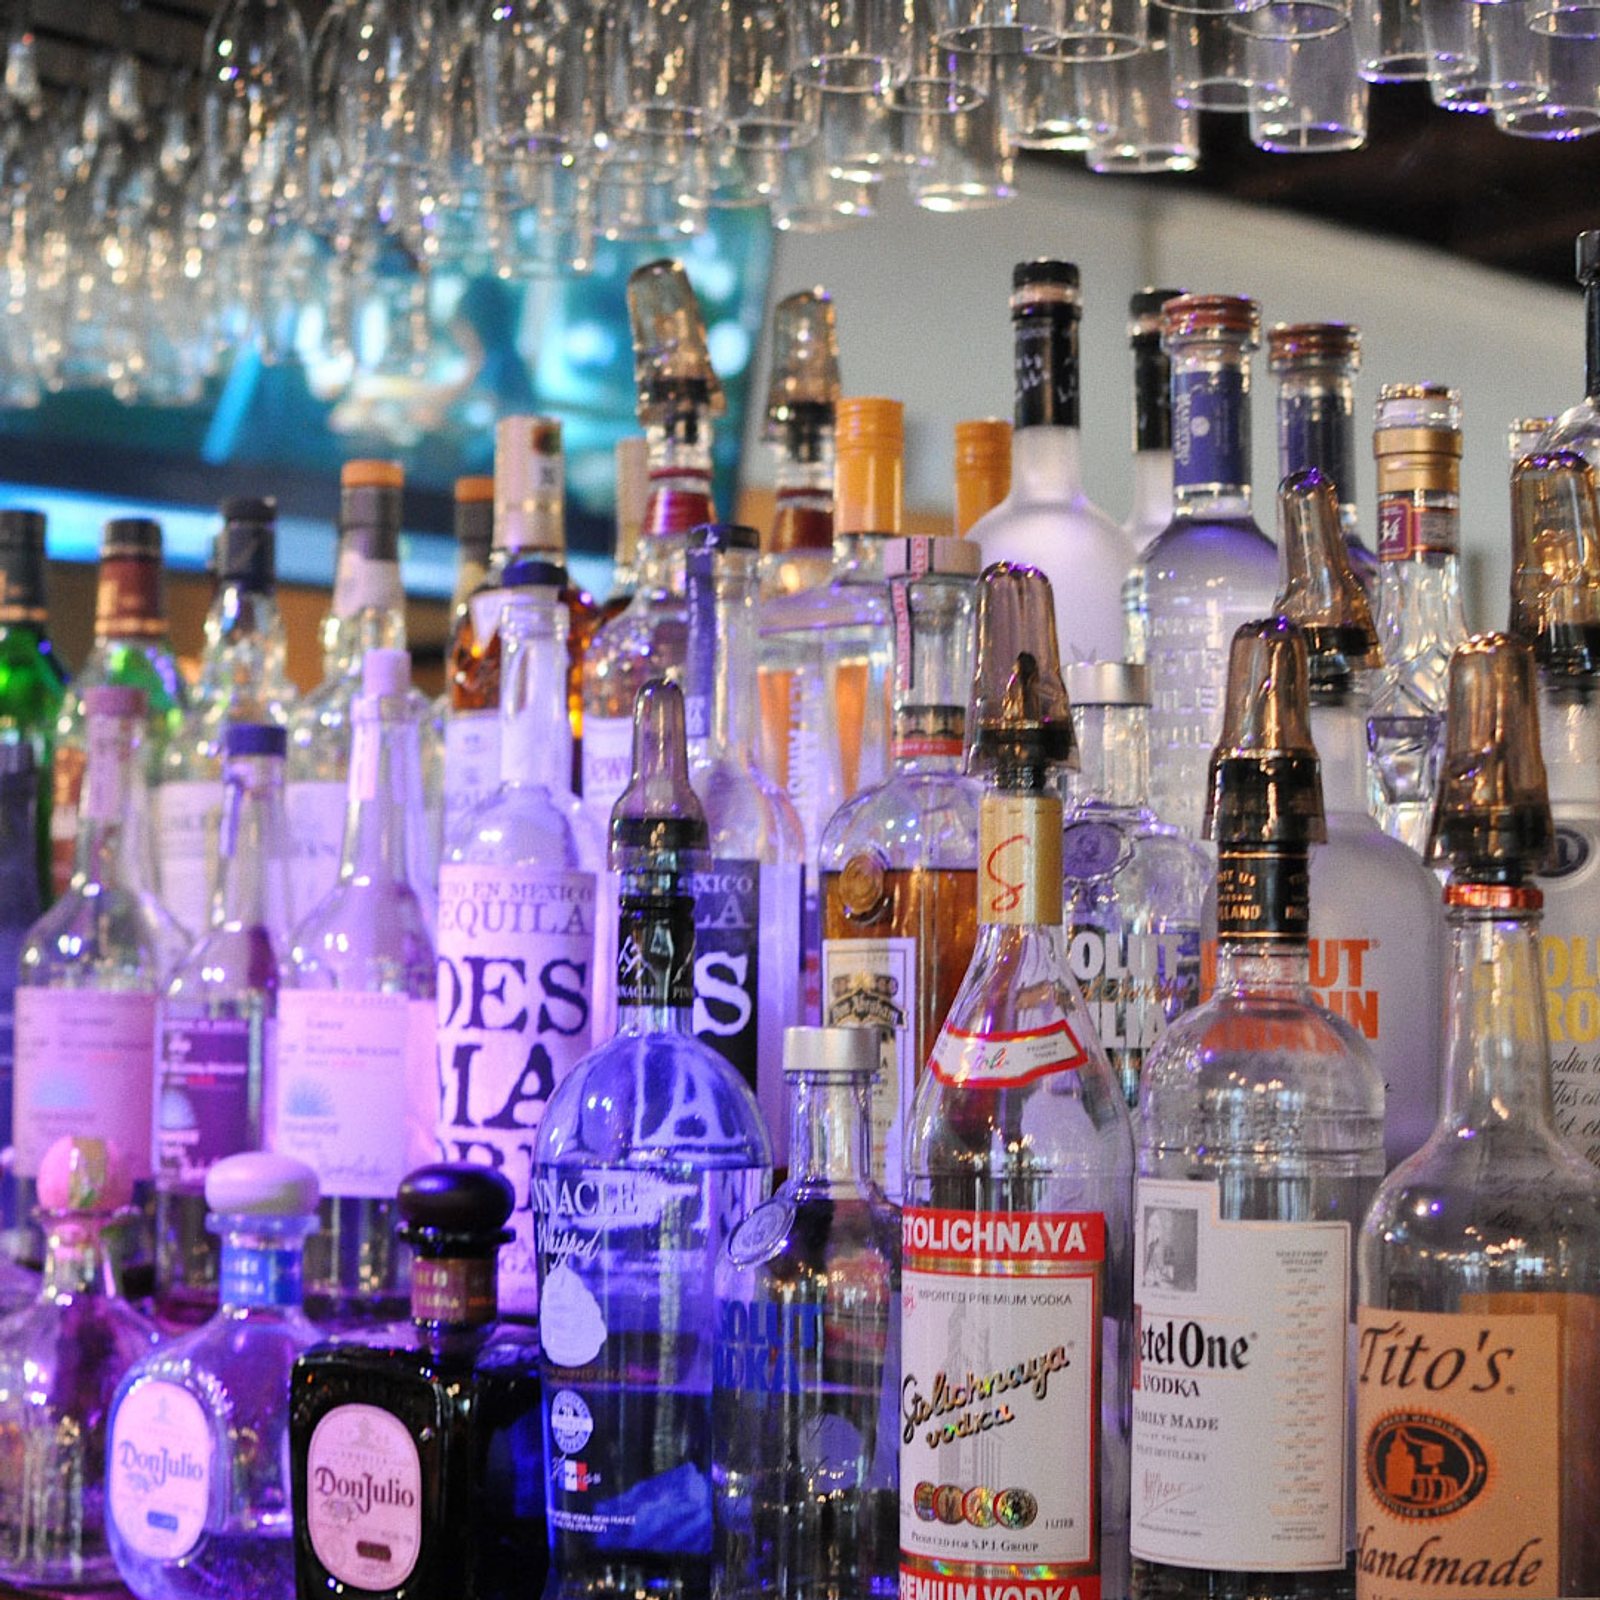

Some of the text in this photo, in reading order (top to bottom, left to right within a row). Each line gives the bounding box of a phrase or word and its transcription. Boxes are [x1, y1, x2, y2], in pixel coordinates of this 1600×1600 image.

[690, 873, 754, 894] XICO
[1540, 935, 1600, 990] OL
[968, 1293, 1027, 1306] PREMIUM
[1031, 1294, 1073, 1306] VODKA
[1143, 1375, 1200, 1397] VODKA
[1170, 1413, 1218, 1431] MADE
[1001, 1541, 1039, 1552] GROUP
